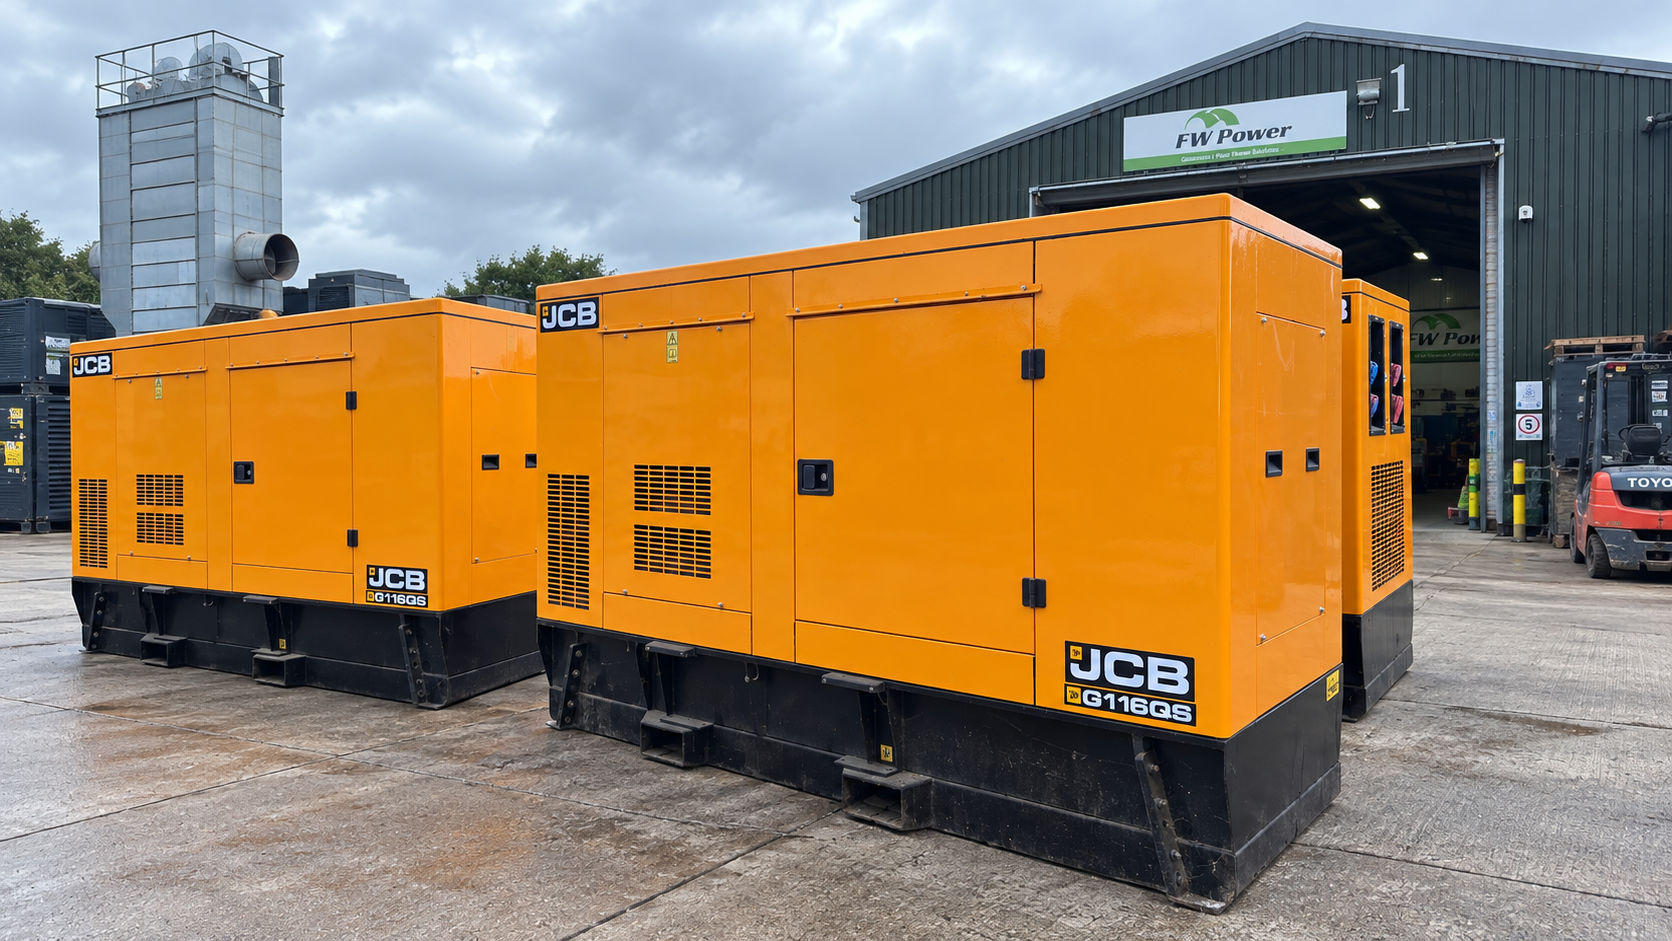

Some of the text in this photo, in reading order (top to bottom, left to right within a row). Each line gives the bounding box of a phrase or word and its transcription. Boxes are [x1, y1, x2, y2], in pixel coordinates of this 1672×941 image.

[1391, 64, 1410, 112] 1
[1176, 125, 1292, 149] FW Power
[542, 301, 597, 329] JCB
[73, 355, 111, 375] JCB
[1525, 419, 1533, 430] 5
[1627, 477, 1672, 488] TOYO
[369, 567, 426, 591] JCB
[374, 592, 427, 606] G116QS
[1070, 648, 1190, 695] JCB
[1082, 689, 1193, 723] G116QS
